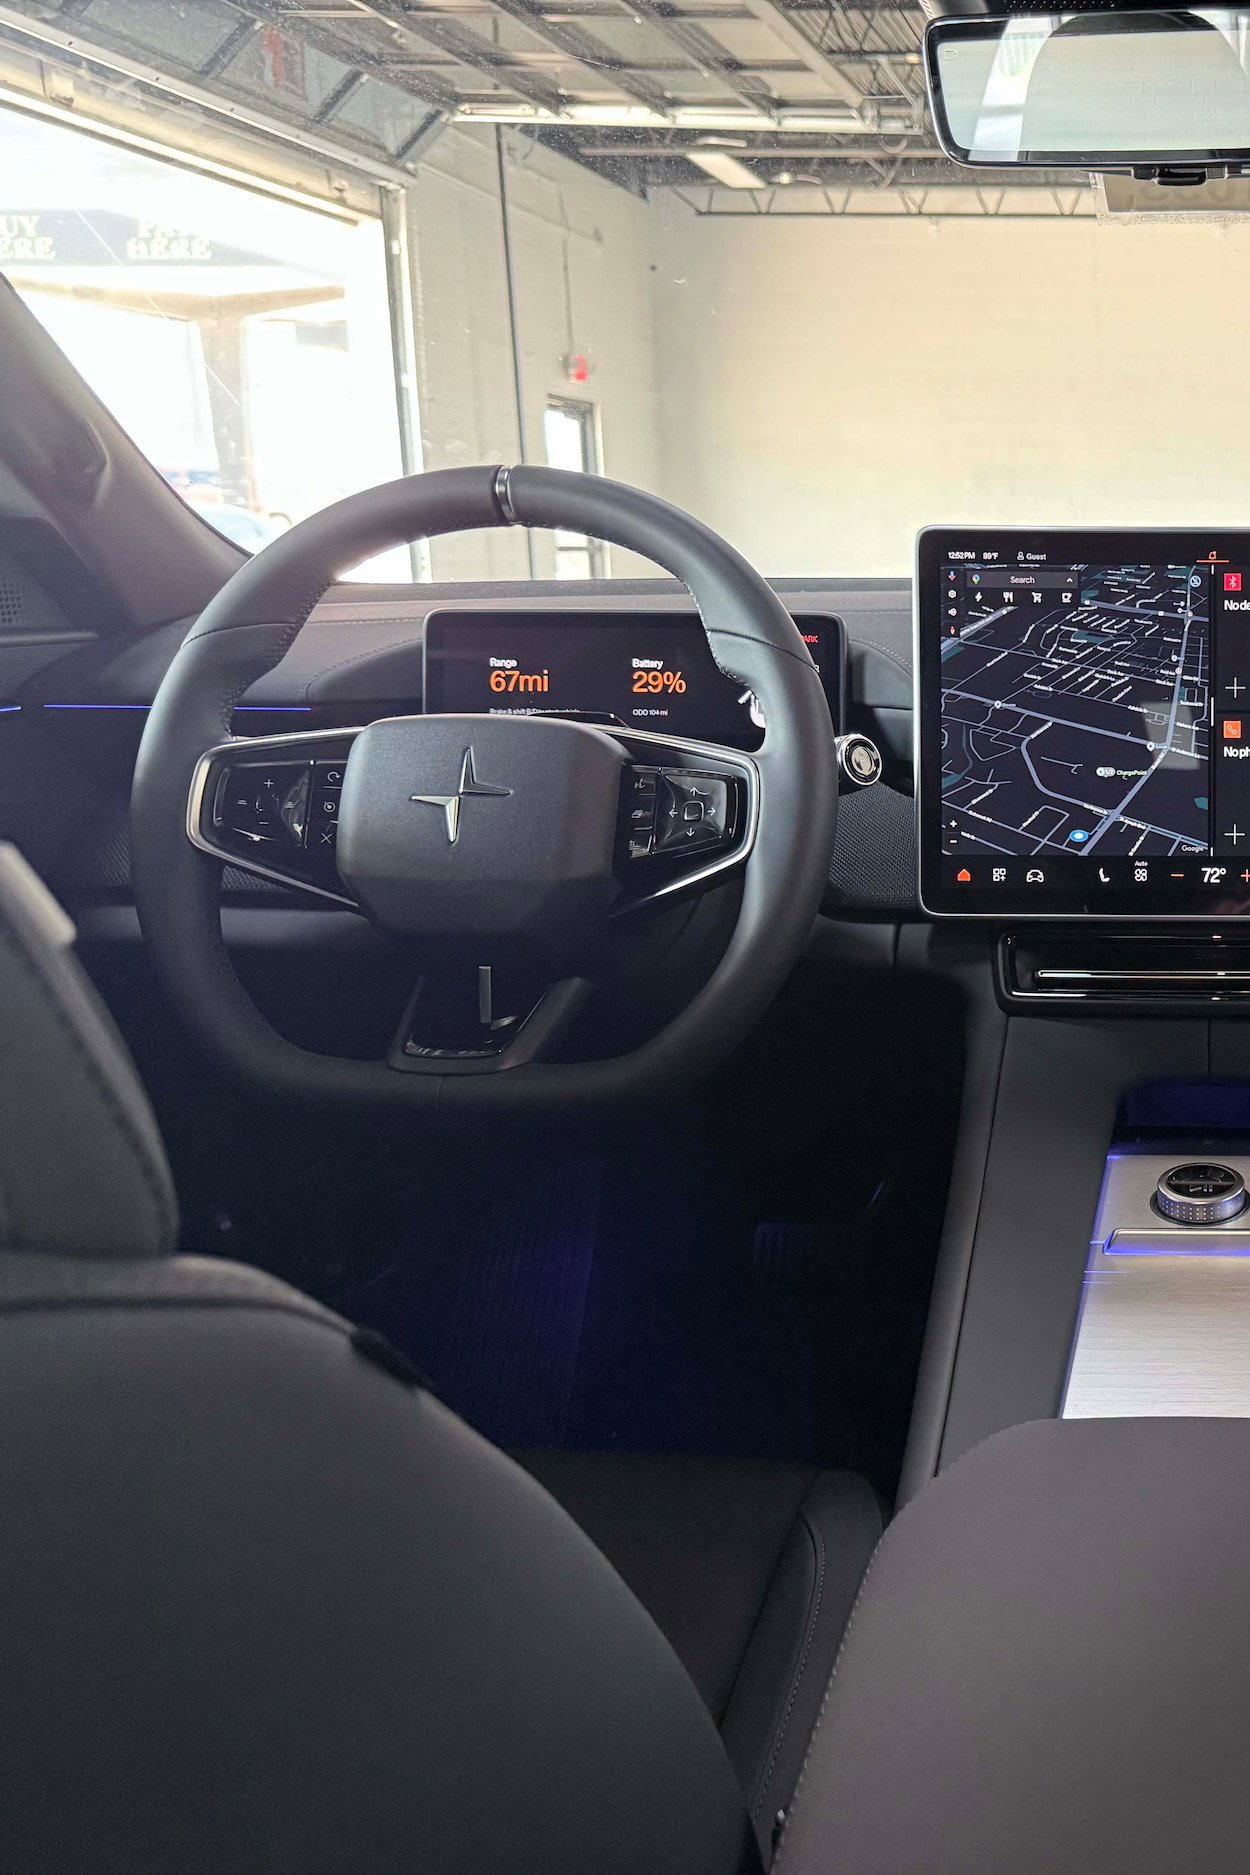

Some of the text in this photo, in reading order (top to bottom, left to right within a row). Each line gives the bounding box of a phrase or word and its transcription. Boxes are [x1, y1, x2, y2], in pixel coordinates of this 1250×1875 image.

[1010, 575, 1035, 584] Search
[1224, 599, 1239, 611] No
[489, 657, 517, 670] Range
[632, 657, 663, 670] Battery
[490, 669, 549, 693] 67mi
[632, 671, 687, 694] 29%
[1223, 746, 1238, 757] No
[1116, 769, 1147, 777] ChargePoint
[1181, 844, 1204, 853] Google
